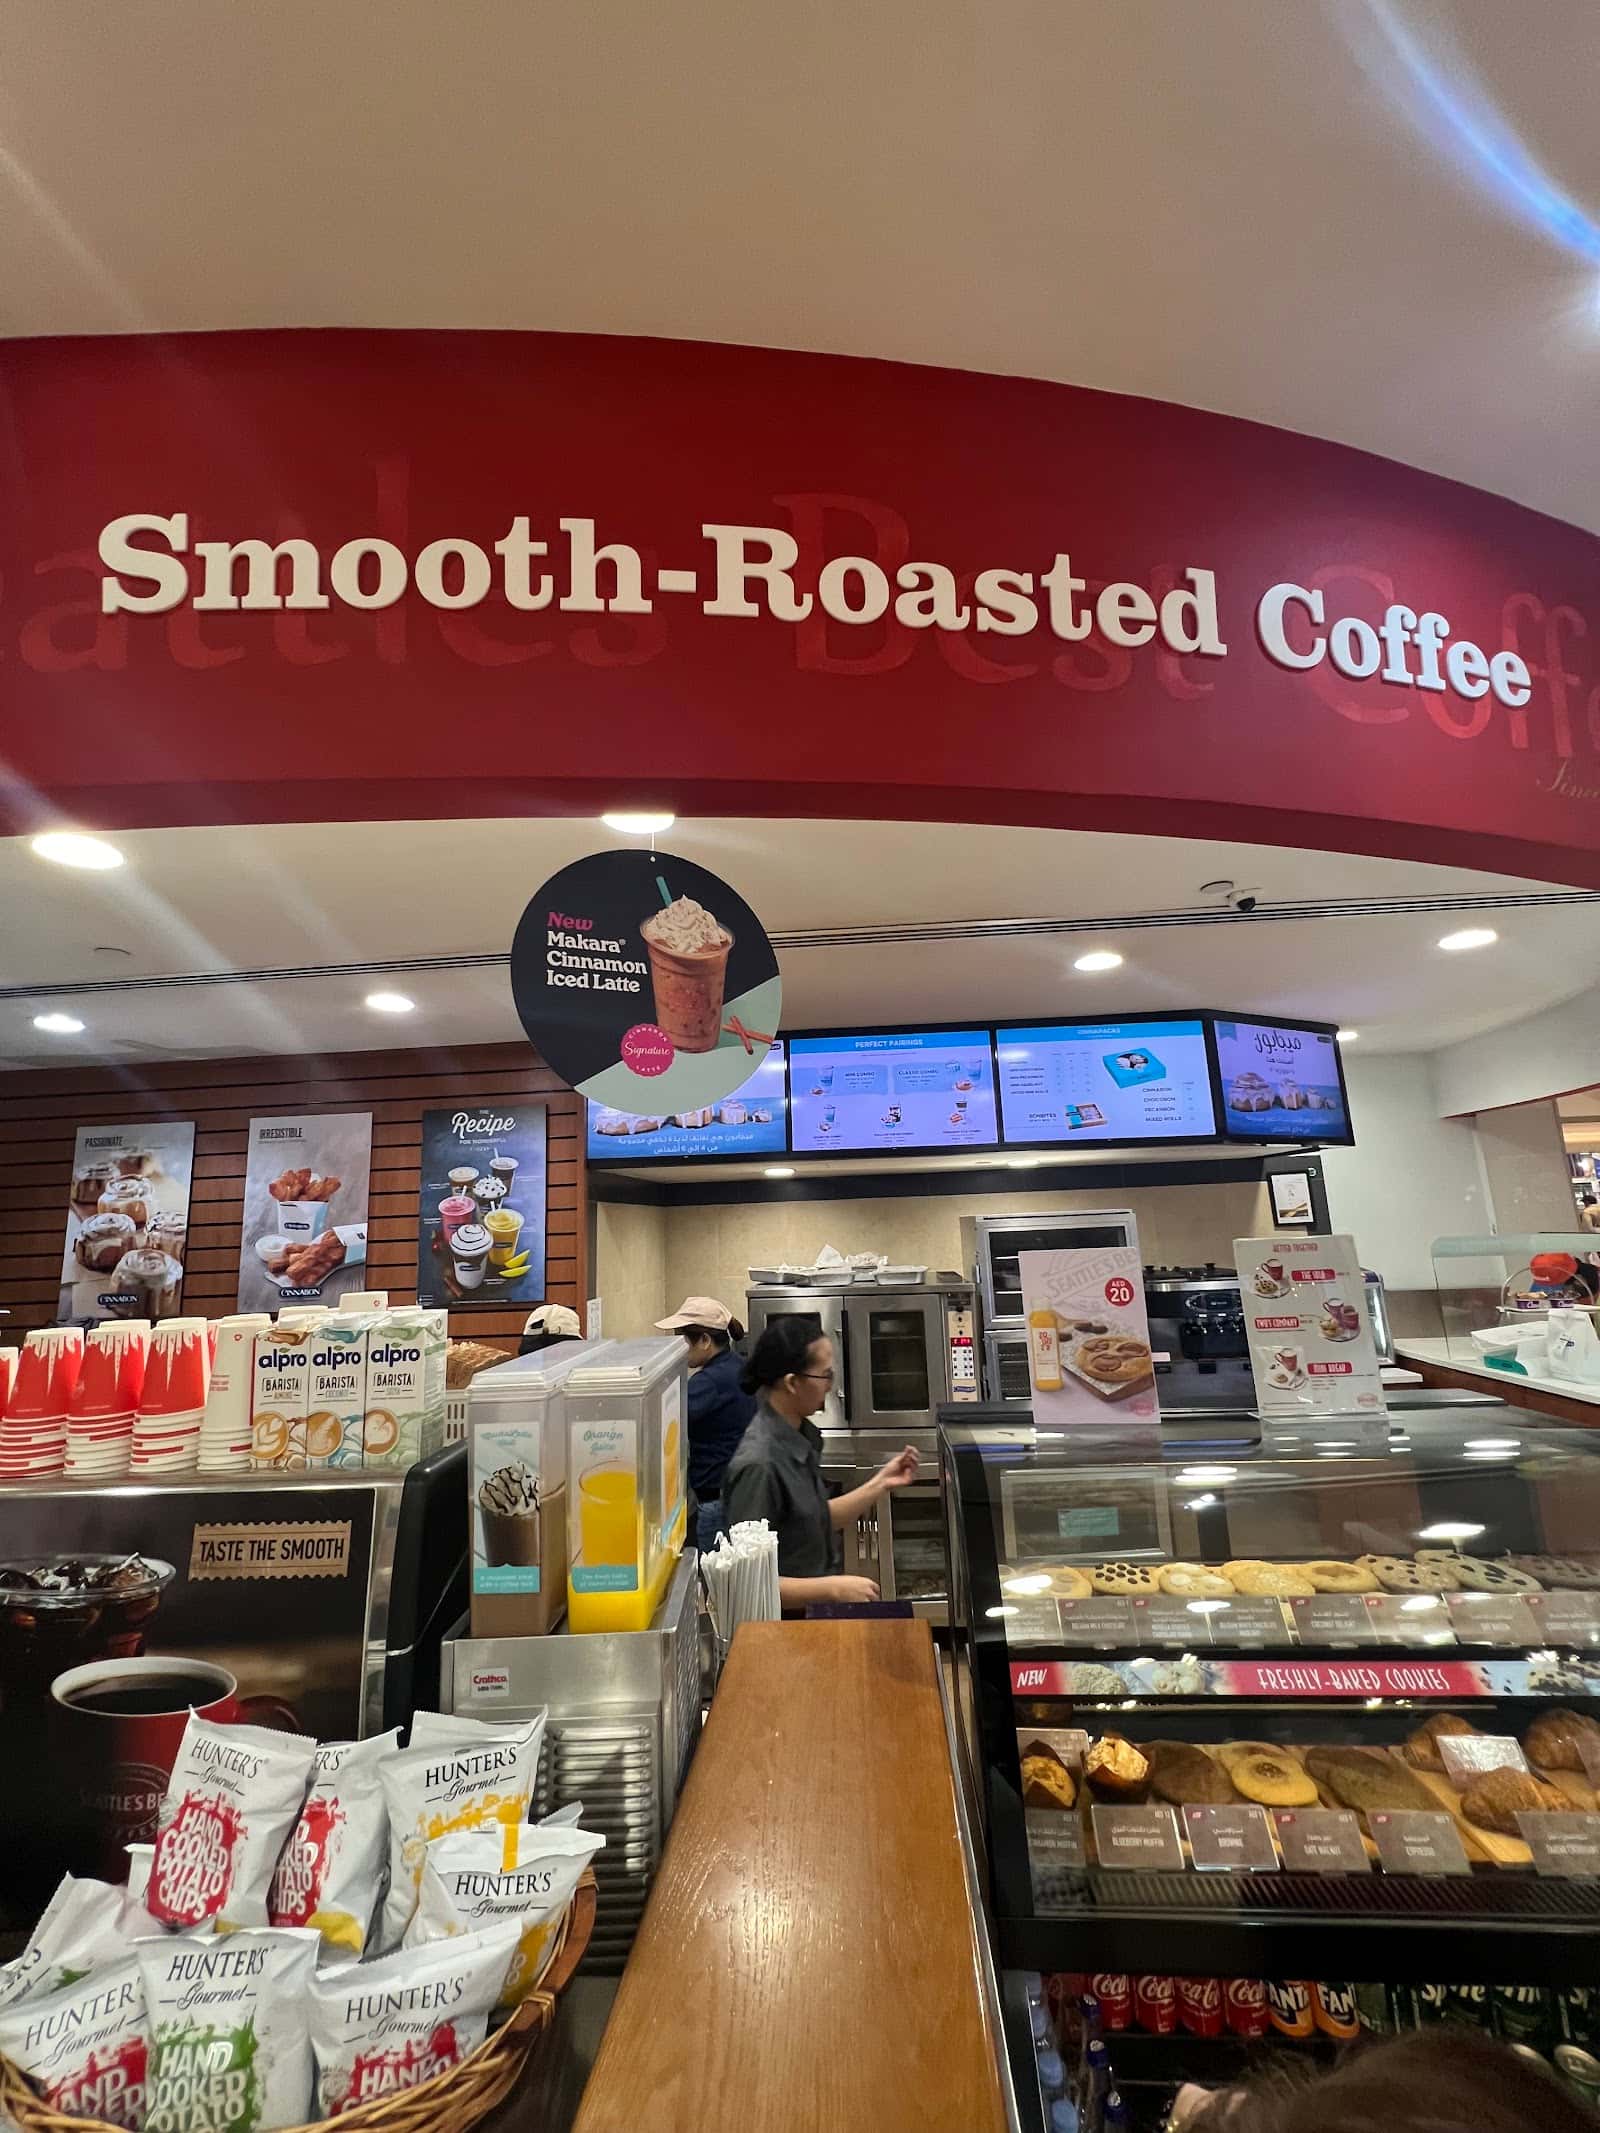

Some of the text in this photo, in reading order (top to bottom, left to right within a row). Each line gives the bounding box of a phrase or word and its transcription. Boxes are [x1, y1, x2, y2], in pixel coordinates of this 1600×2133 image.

[98, 511, 1532, 707] Smooth-Roasted Coffee
[547, 912, 593, 931] New
[546, 950, 648, 975] Cinnamon
[546, 970, 641, 993] Iced Latte
[624, 1041, 671, 1059] Signature
[855, 1038, 923, 1048] PERFECT PAIRINGS
[259, 1127, 303, 1140] IRRESISTIBLE
[452, 1111, 516, 1139] Recipe
[84, 1136, 124, 1148] PASSIONATE
[280, 1288, 321, 1297] CINNABON
[1110, 1287, 1130, 1303] 20
[1111, 1280, 1126, 1288] AED
[99, 1295, 139, 1304] CINNABON
[258, 1348, 307, 1372] alpro
[312, 1346, 361, 1370] alpro
[370, 1343, 421, 1368] alpro
[265, 1378, 299, 1391] BARISTA
[319, 1375, 355, 1389] BARISTA
[376, 1372, 412, 1386] BARISTA
[199, 1538, 345, 1562] TASTE THE SMOOTH
[1016, 1668, 1048, 1688] NEW
[1257, 1665, 1452, 1691] FRESHLY-BAKED COOKIES
[191, 1737, 264, 1780] HUNTER'S
[311, 1751, 342, 1771] ER'S
[424, 1746, 518, 1788] HUNTER'S
[199, 1767, 237, 1792] Gourmet
[443, 1775, 501, 1802] Gourmet
[180, 1807, 224, 1843] HAND
[161, 1829, 228, 1871] COOKED
[156, 1851, 224, 1897] POTATO
[454, 1871, 552, 1898] HUNTER'S
[158, 1880, 210, 1920] CHIPS
[470, 1898, 530, 1919] Gourmet
[166, 1948, 268, 1982] HUNTER'S
[177, 1982, 247, 2010] Gourmet
[345, 1976, 464, 2024] HUNTER'S
[1319, 1983, 1354, 2013] FAN
[369, 2015, 441, 2041] Gourmet
[44, 2017, 126, 2067] Gourmet
[160, 2041, 234, 2077] HAND
